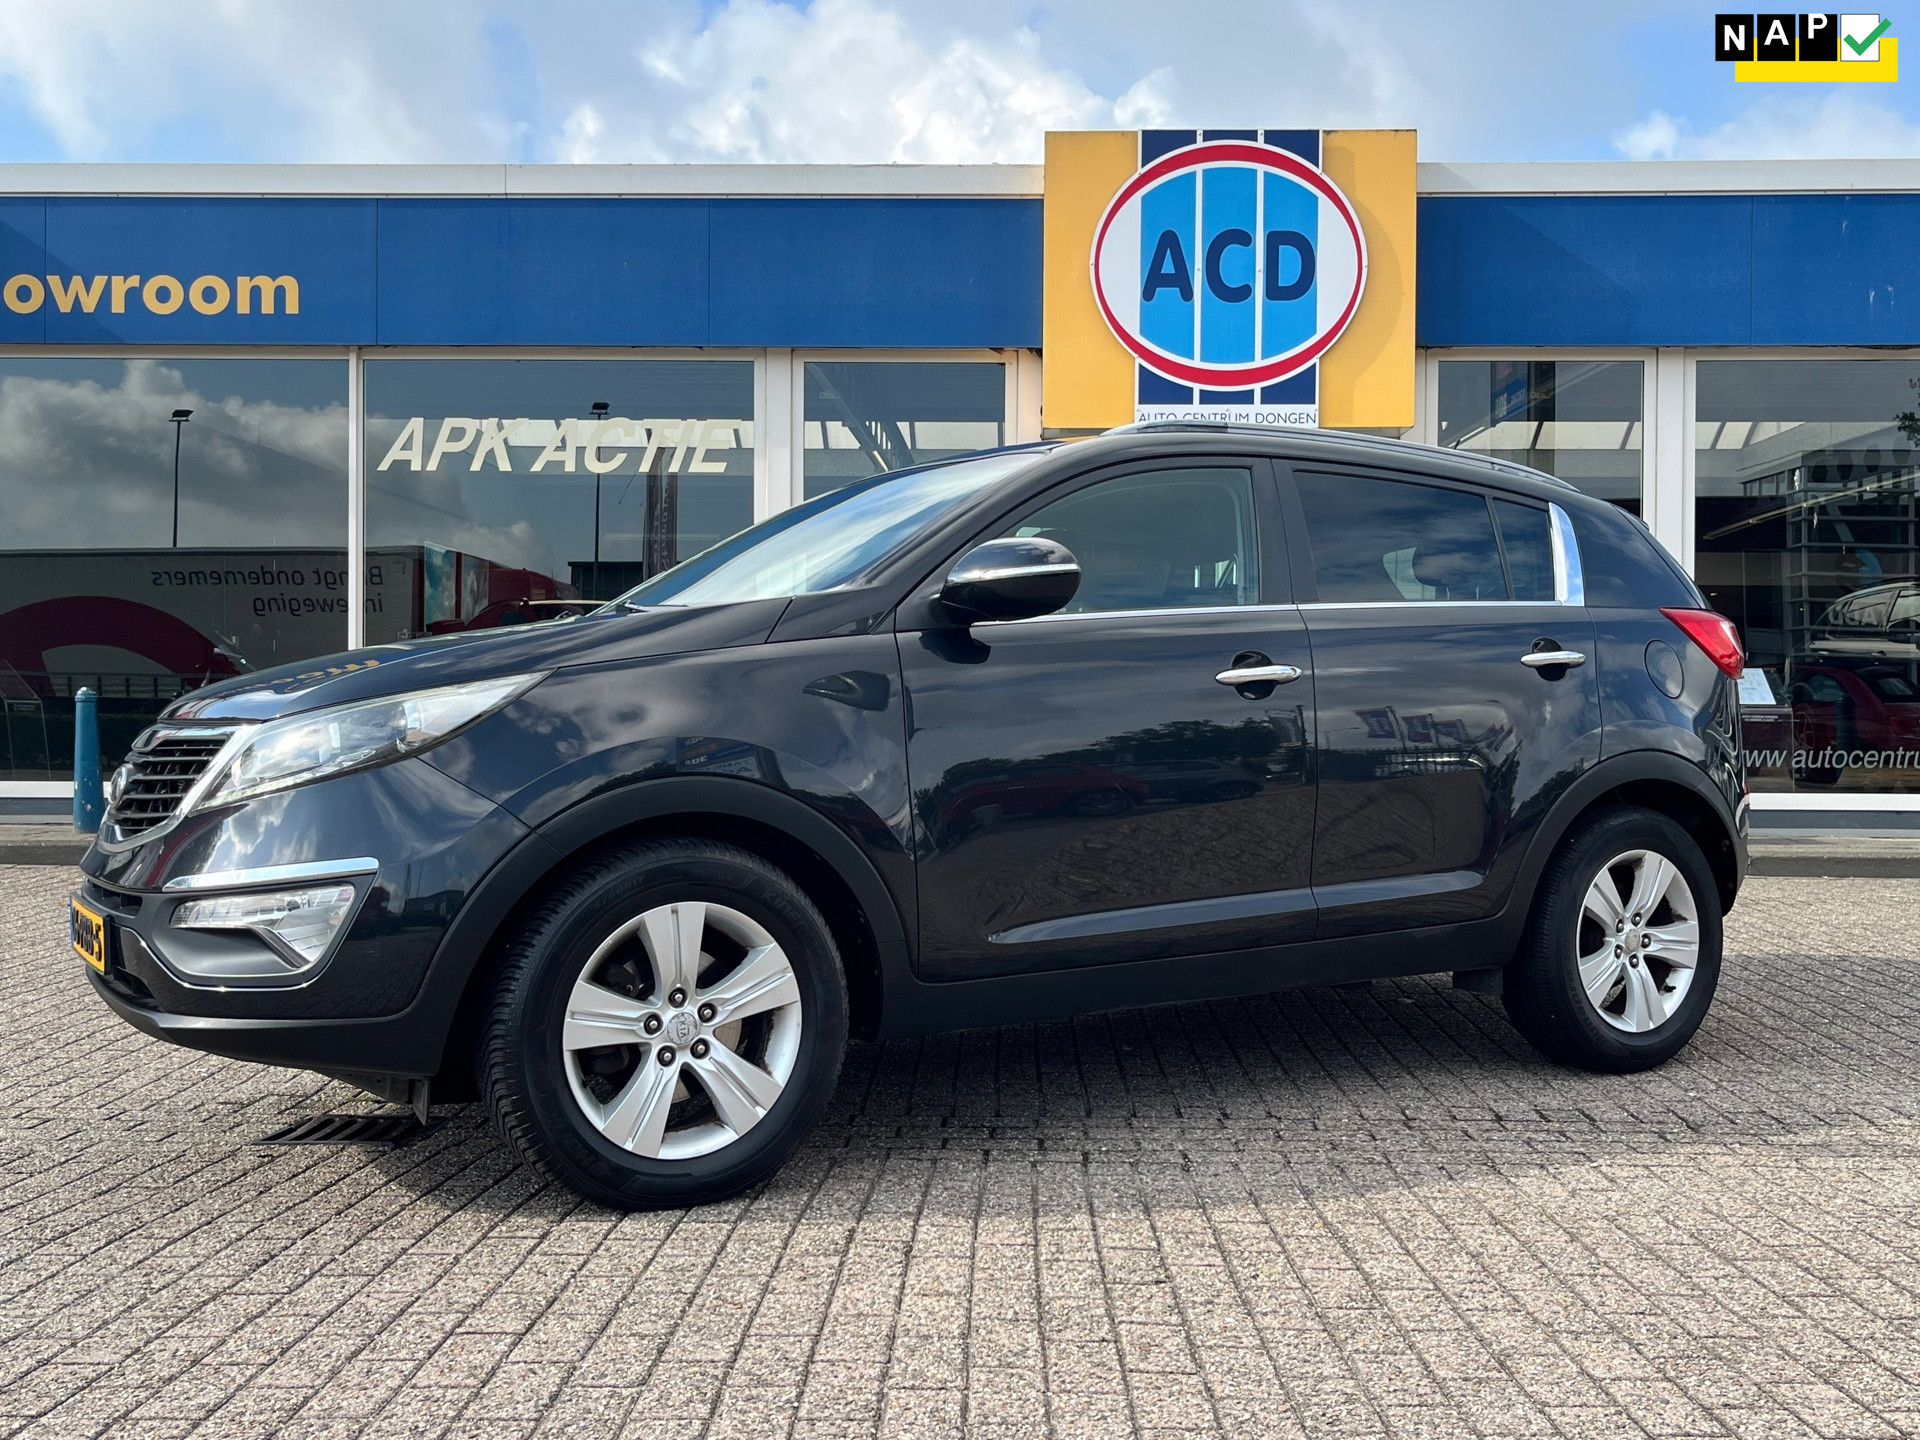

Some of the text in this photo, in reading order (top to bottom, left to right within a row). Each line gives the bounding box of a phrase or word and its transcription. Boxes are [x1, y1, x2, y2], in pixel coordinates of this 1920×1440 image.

[1142, 228, 1316, 303] ACD
[3, 274, 299, 315] owroom
[1255, 412, 1317, 424] DONGEN
[376, 417, 742, 474] APK ACTIE
[679, 1020, 687, 1039] KIA
